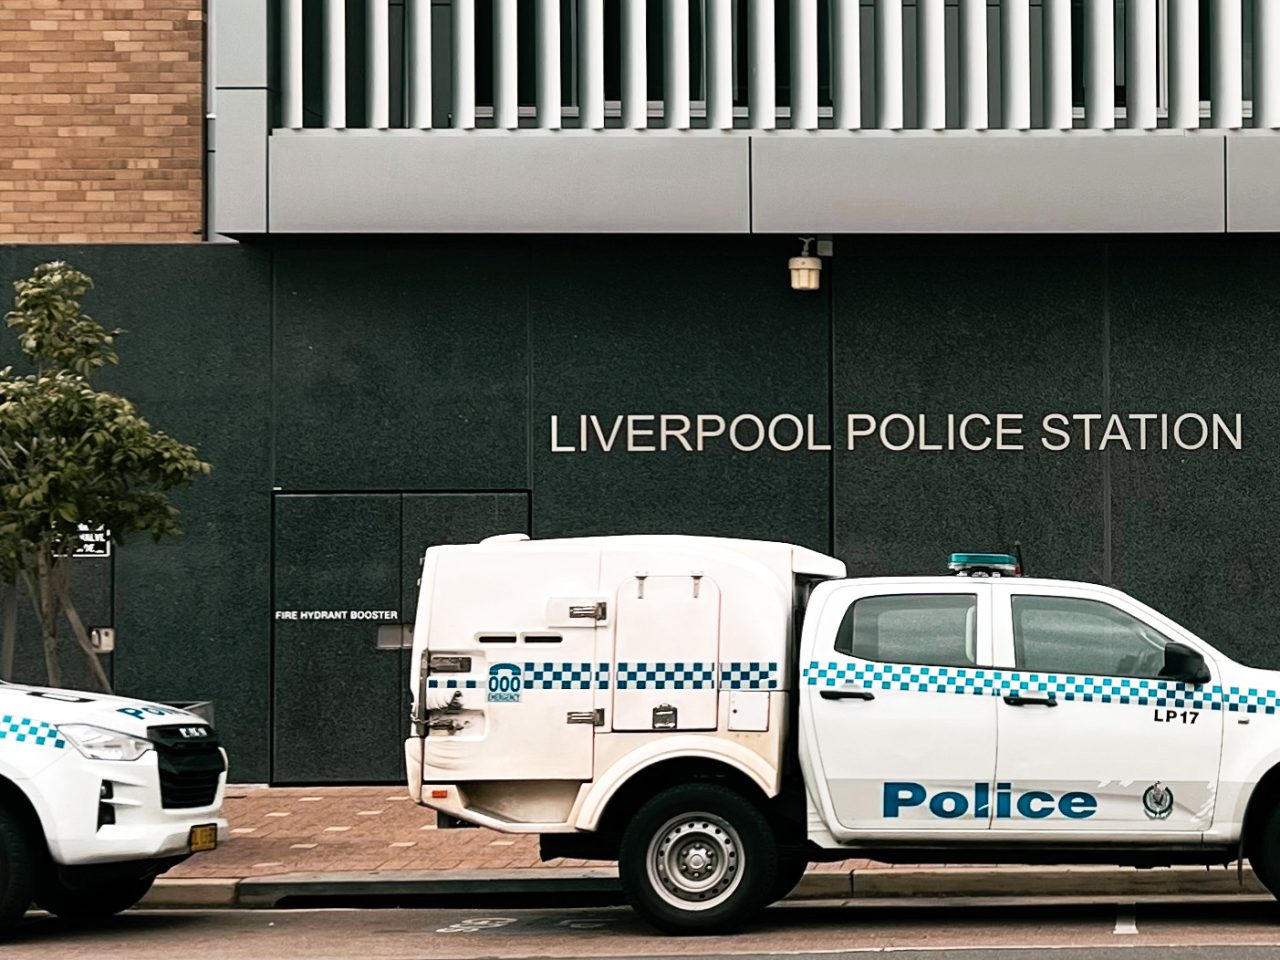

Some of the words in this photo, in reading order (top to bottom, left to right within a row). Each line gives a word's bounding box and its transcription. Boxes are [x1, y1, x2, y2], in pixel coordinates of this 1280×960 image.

[551, 414, 832, 452] LIVERPOOL
[847, 413, 1024, 451] POLICE
[1040, 413, 1242, 451] STATION
[275, 610, 299, 620] FIRE
[300, 610, 348, 620] HYDRANT
[350, 610, 398, 620] BOOSTER
[489, 676, 520, 692] 000
[1154, 709, 1200, 724] LP17
[883, 782, 1098, 819] Police
